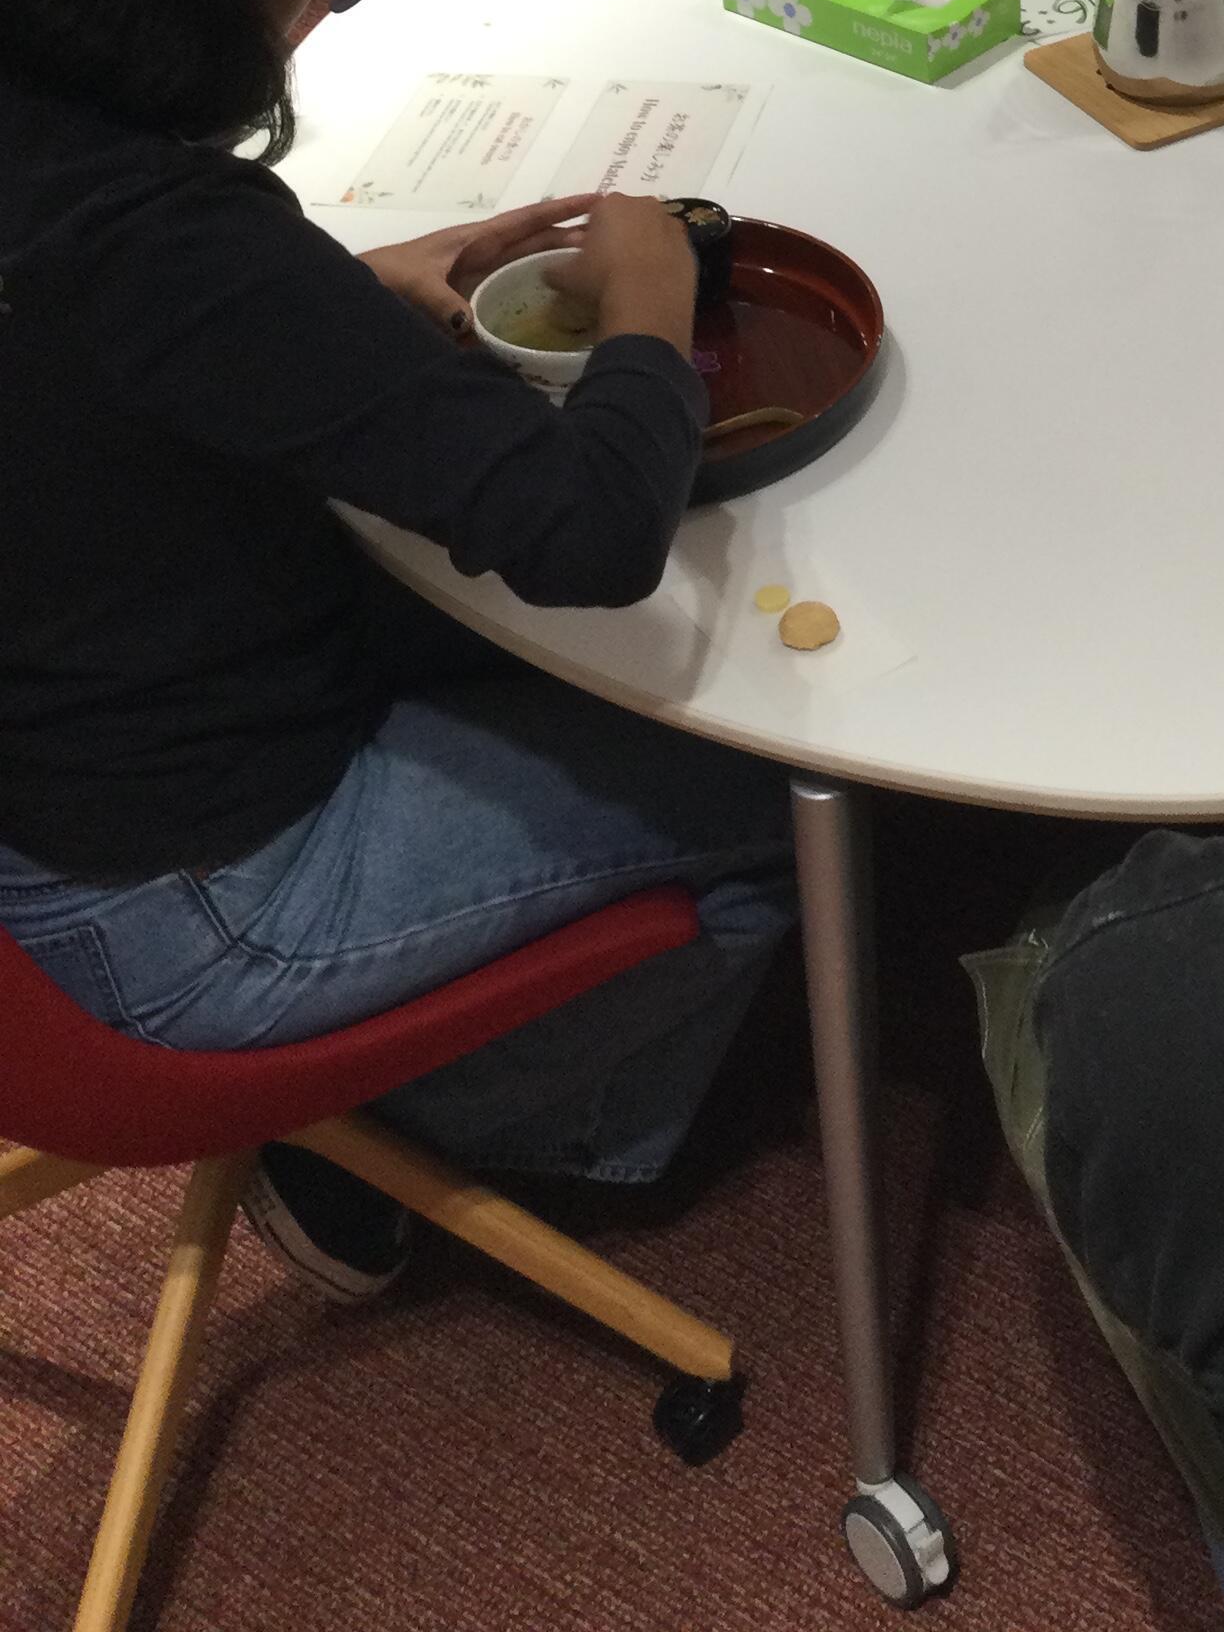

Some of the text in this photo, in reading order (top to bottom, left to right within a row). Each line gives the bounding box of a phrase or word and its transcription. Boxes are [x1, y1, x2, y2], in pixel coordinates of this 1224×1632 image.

[852, 20, 913, 55] nepia
[635, 98, 660, 118] How
[629, 121, 647, 130] to
[611, 132, 643, 155] enjoy
[638, 112, 692, 182] お茶の楽しみ方
